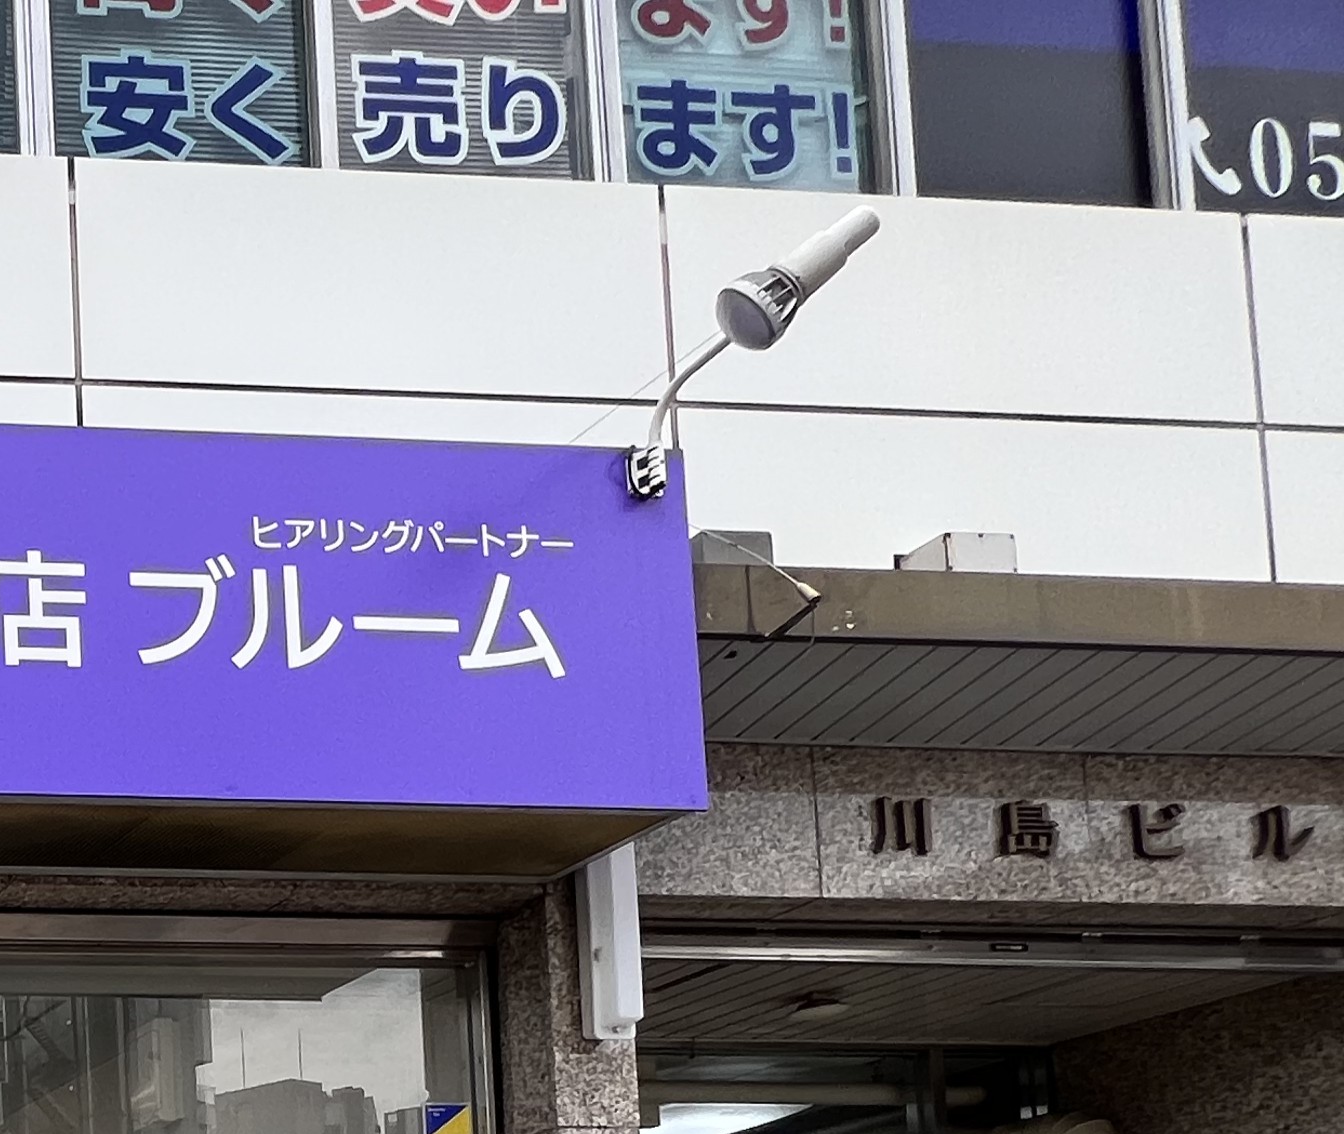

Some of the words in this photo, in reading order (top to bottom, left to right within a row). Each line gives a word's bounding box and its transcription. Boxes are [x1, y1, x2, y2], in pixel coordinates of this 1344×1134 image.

[252, 516, 574, 558] ヒアリングパートナー
[129, 554, 566, 679] ブルーム
[870, 796, 1315, 862] 川島ビル
